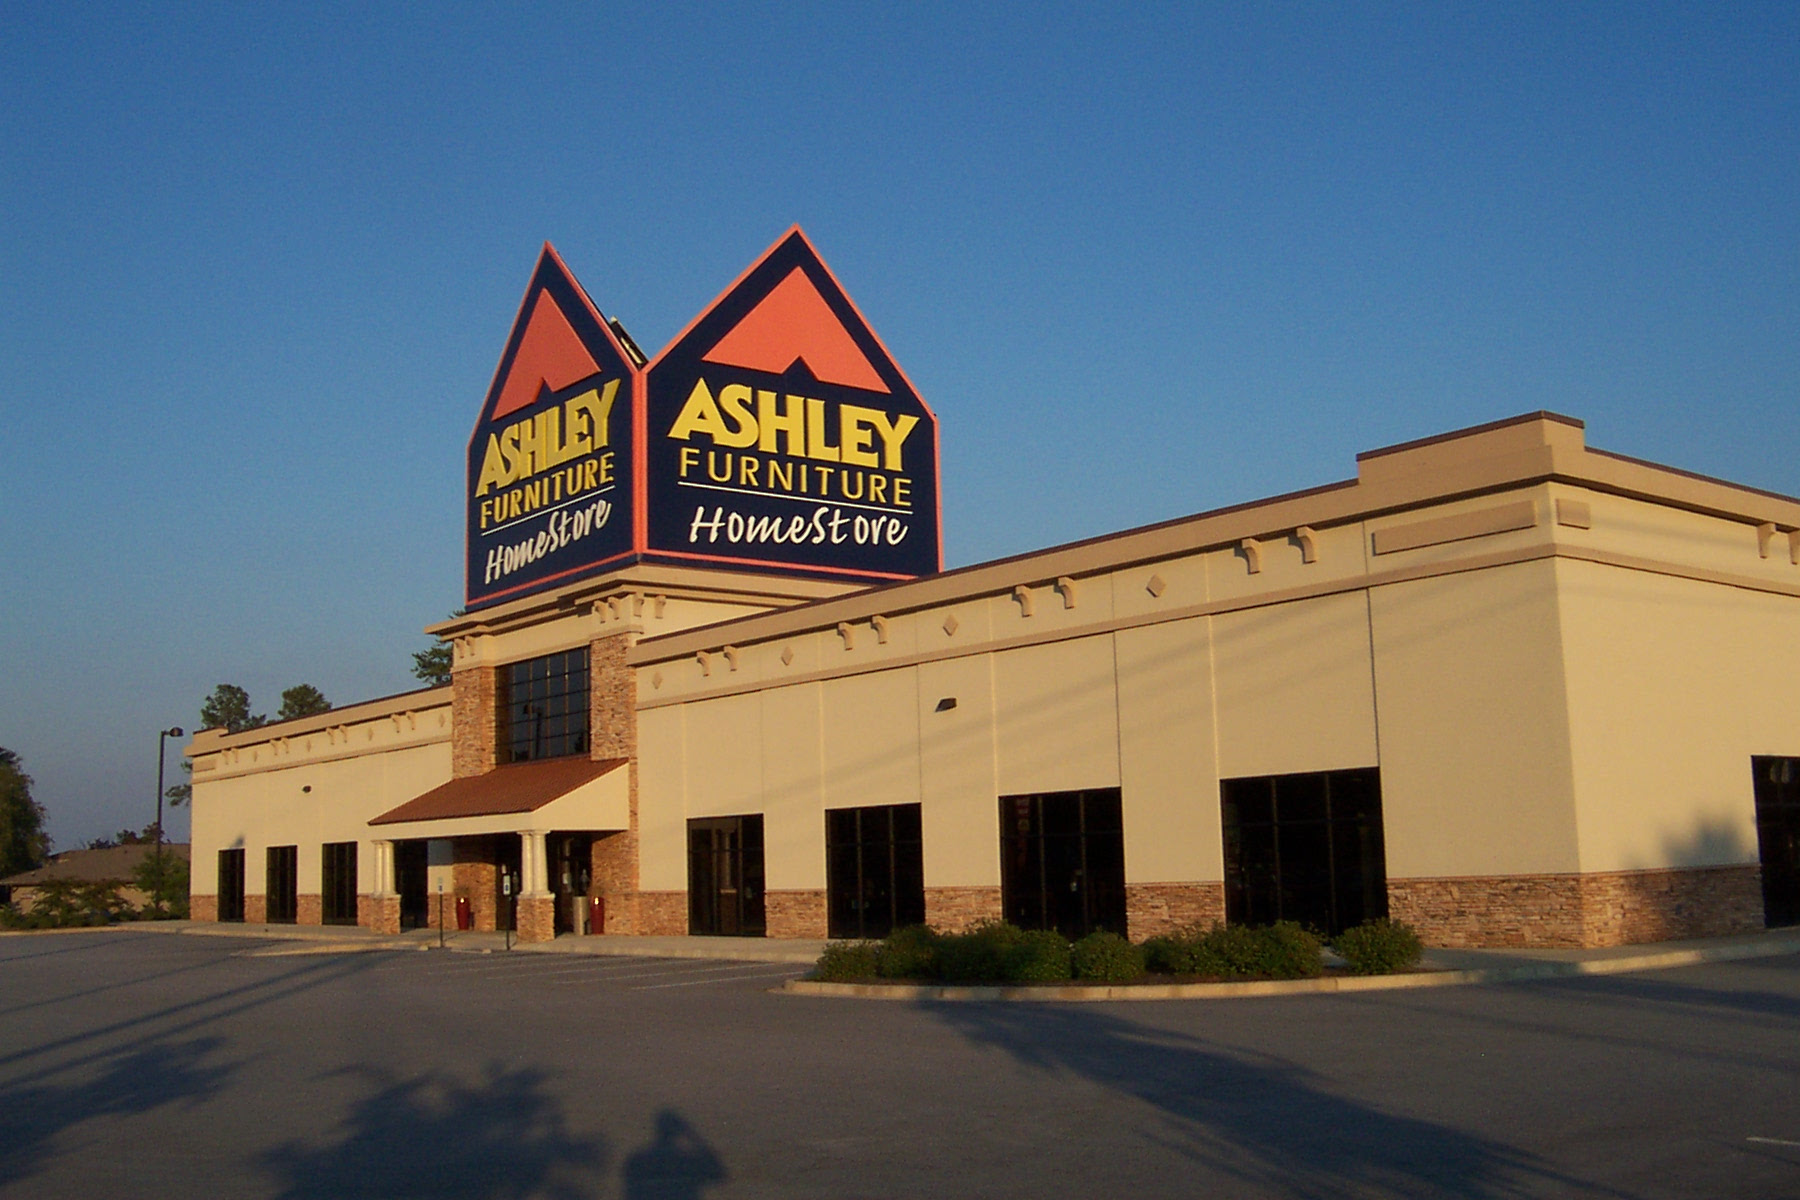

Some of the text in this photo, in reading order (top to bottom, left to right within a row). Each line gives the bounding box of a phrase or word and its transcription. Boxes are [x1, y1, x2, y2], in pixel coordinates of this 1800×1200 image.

[475, 378, 621, 498] ASHLEY
[667, 377, 921, 472] ASHLEY
[480, 452, 615, 529] FURNITURE
[679, 447, 912, 507] FURNITURE
[485, 499, 612, 585] HomeStore
[688, 505, 909, 545] HomeStore
